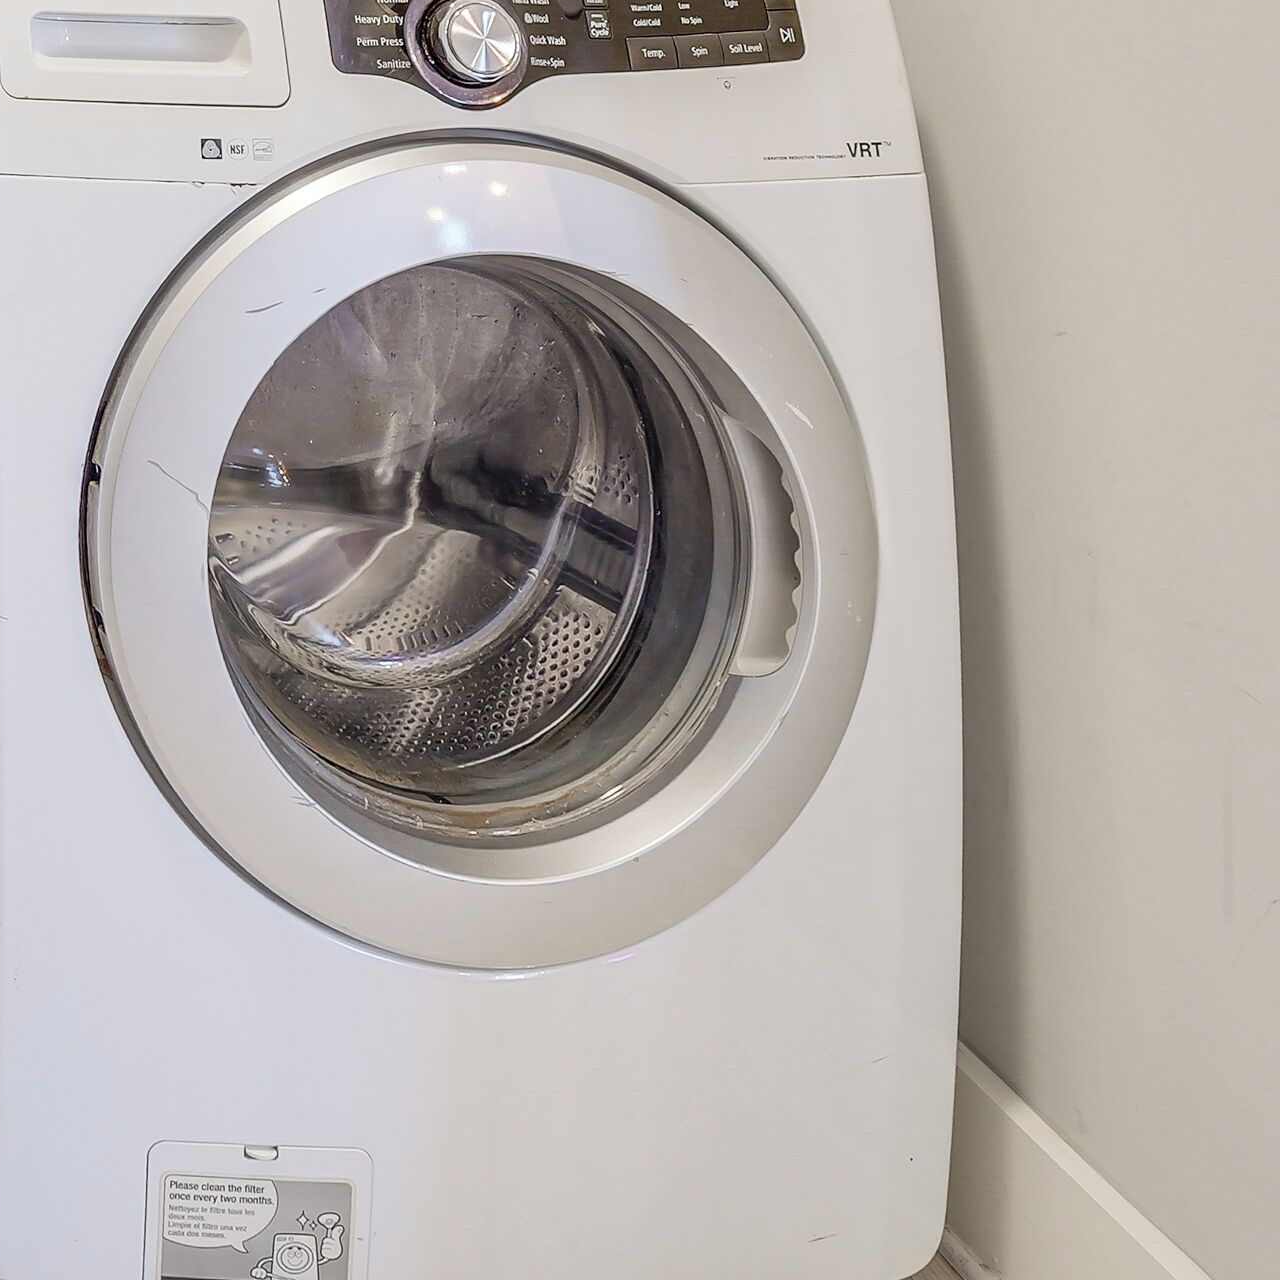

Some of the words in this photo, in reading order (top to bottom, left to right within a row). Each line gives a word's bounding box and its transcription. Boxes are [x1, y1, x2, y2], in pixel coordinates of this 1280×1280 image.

[354, 15, 381, 25] Heavy
[383, 15, 403, 25] Duty
[531, 14, 549, 23] Wool
[356, 37, 379, 46] Perm
[381, 37, 404, 46] Press
[529, 35, 547, 45] Quick
[547, 35, 566, 45] Wash
[642, 48, 666, 59] Temp.
[691, 47, 708, 57] Spin
[729, 44, 742, 54] Soil
[743, 43, 763, 53] Level
[376, 59, 411, 69] Sanitize
[530, 57, 565, 68] Rinse+Spin
[230, 144, 245, 154] NSF
[169, 1180, 199, 1190] Please
[201, 1183, 226, 1192] clean
[228, 1184, 242, 1193] the
[245, 1184, 265, 1194] filter
[169, 1192, 191, 1201] once
[193, 1195, 218, 1204] every
[220, 1195, 236, 1204] two
[239, 1196, 274, 1205] months.
[168, 1204, 199, 1213] Nettoyez
